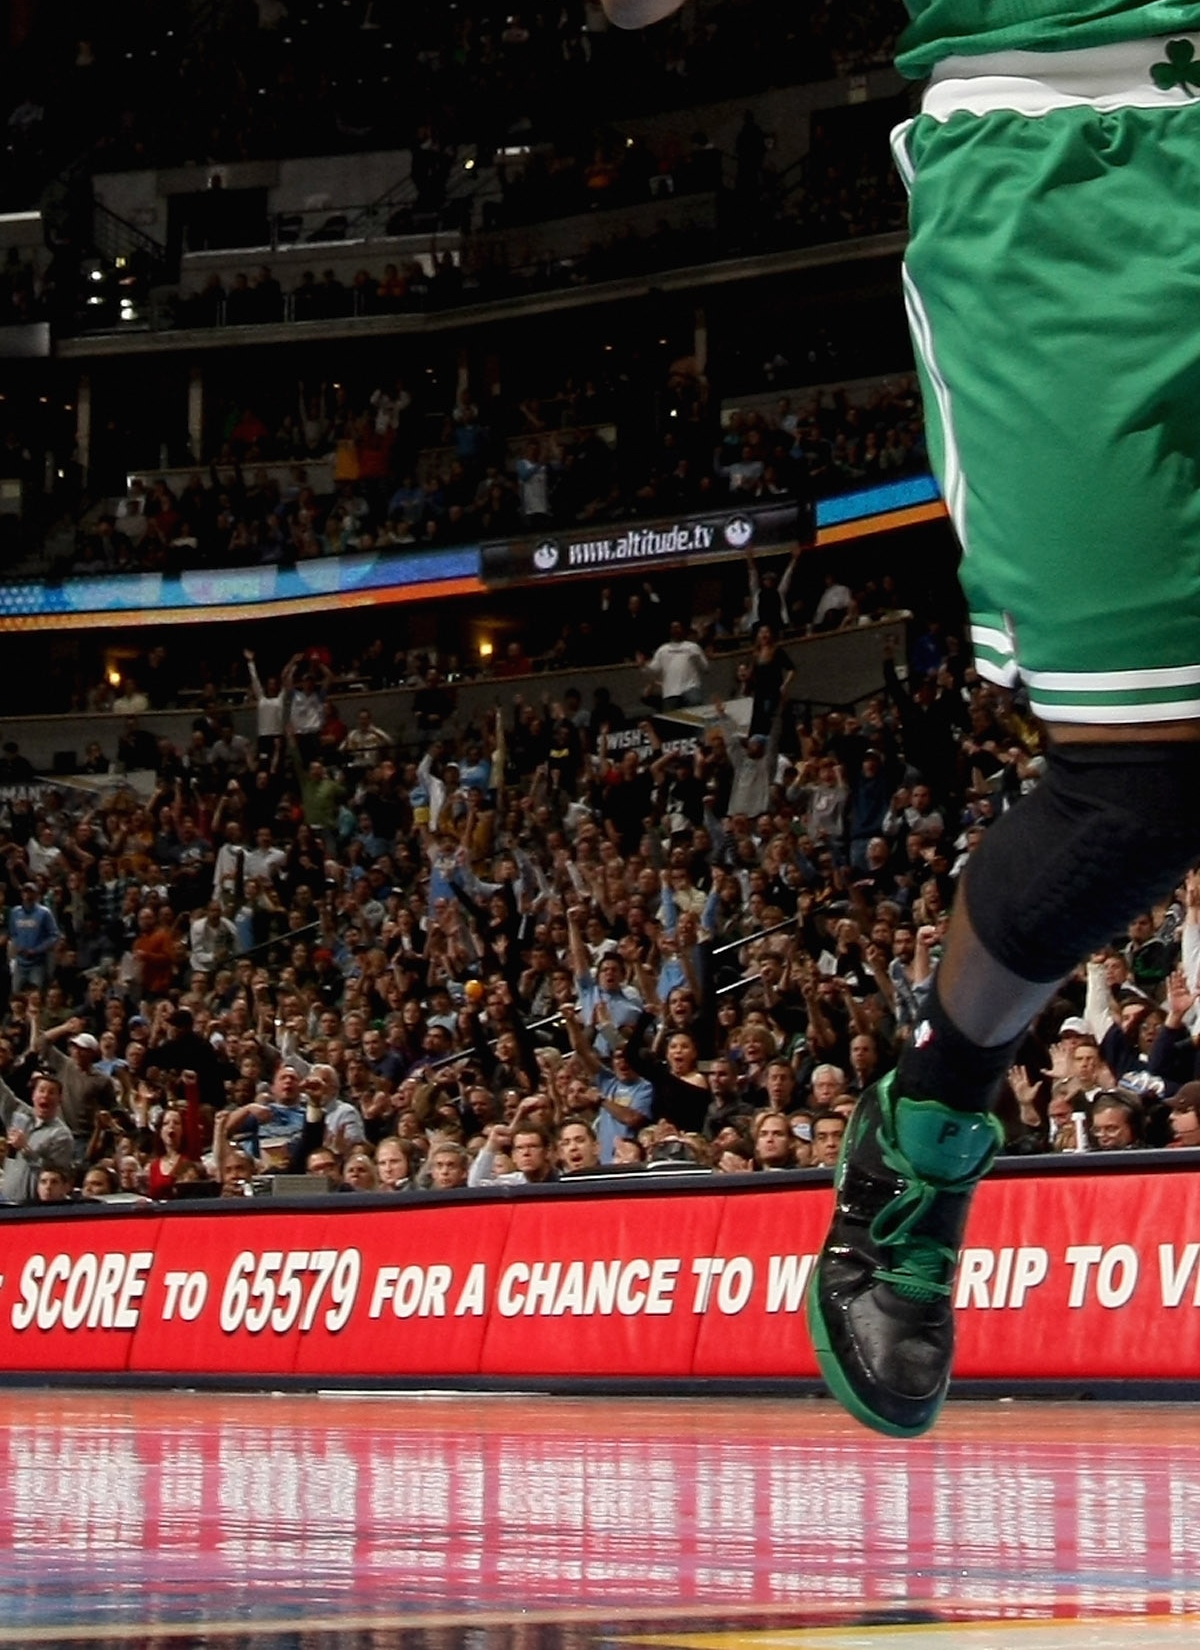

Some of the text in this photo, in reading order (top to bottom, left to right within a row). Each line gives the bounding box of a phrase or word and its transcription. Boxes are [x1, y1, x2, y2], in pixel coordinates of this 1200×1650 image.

[569, 525, 714, 565] www.altitude.tv
[11, 1252, 154, 1331] SCORE
[162, 1270, 209, 1321] TO
[219, 1248, 361, 1333] 65579
[369, 1264, 452, 1318] FOR
[455, 1263, 485, 1316] A
[499, 1257, 681, 1317] CHANCE
[691, 1255, 754, 1316] TO
[955, 1246, 1049, 1309] RIP
[1065, 1244, 1139, 1309] TO
